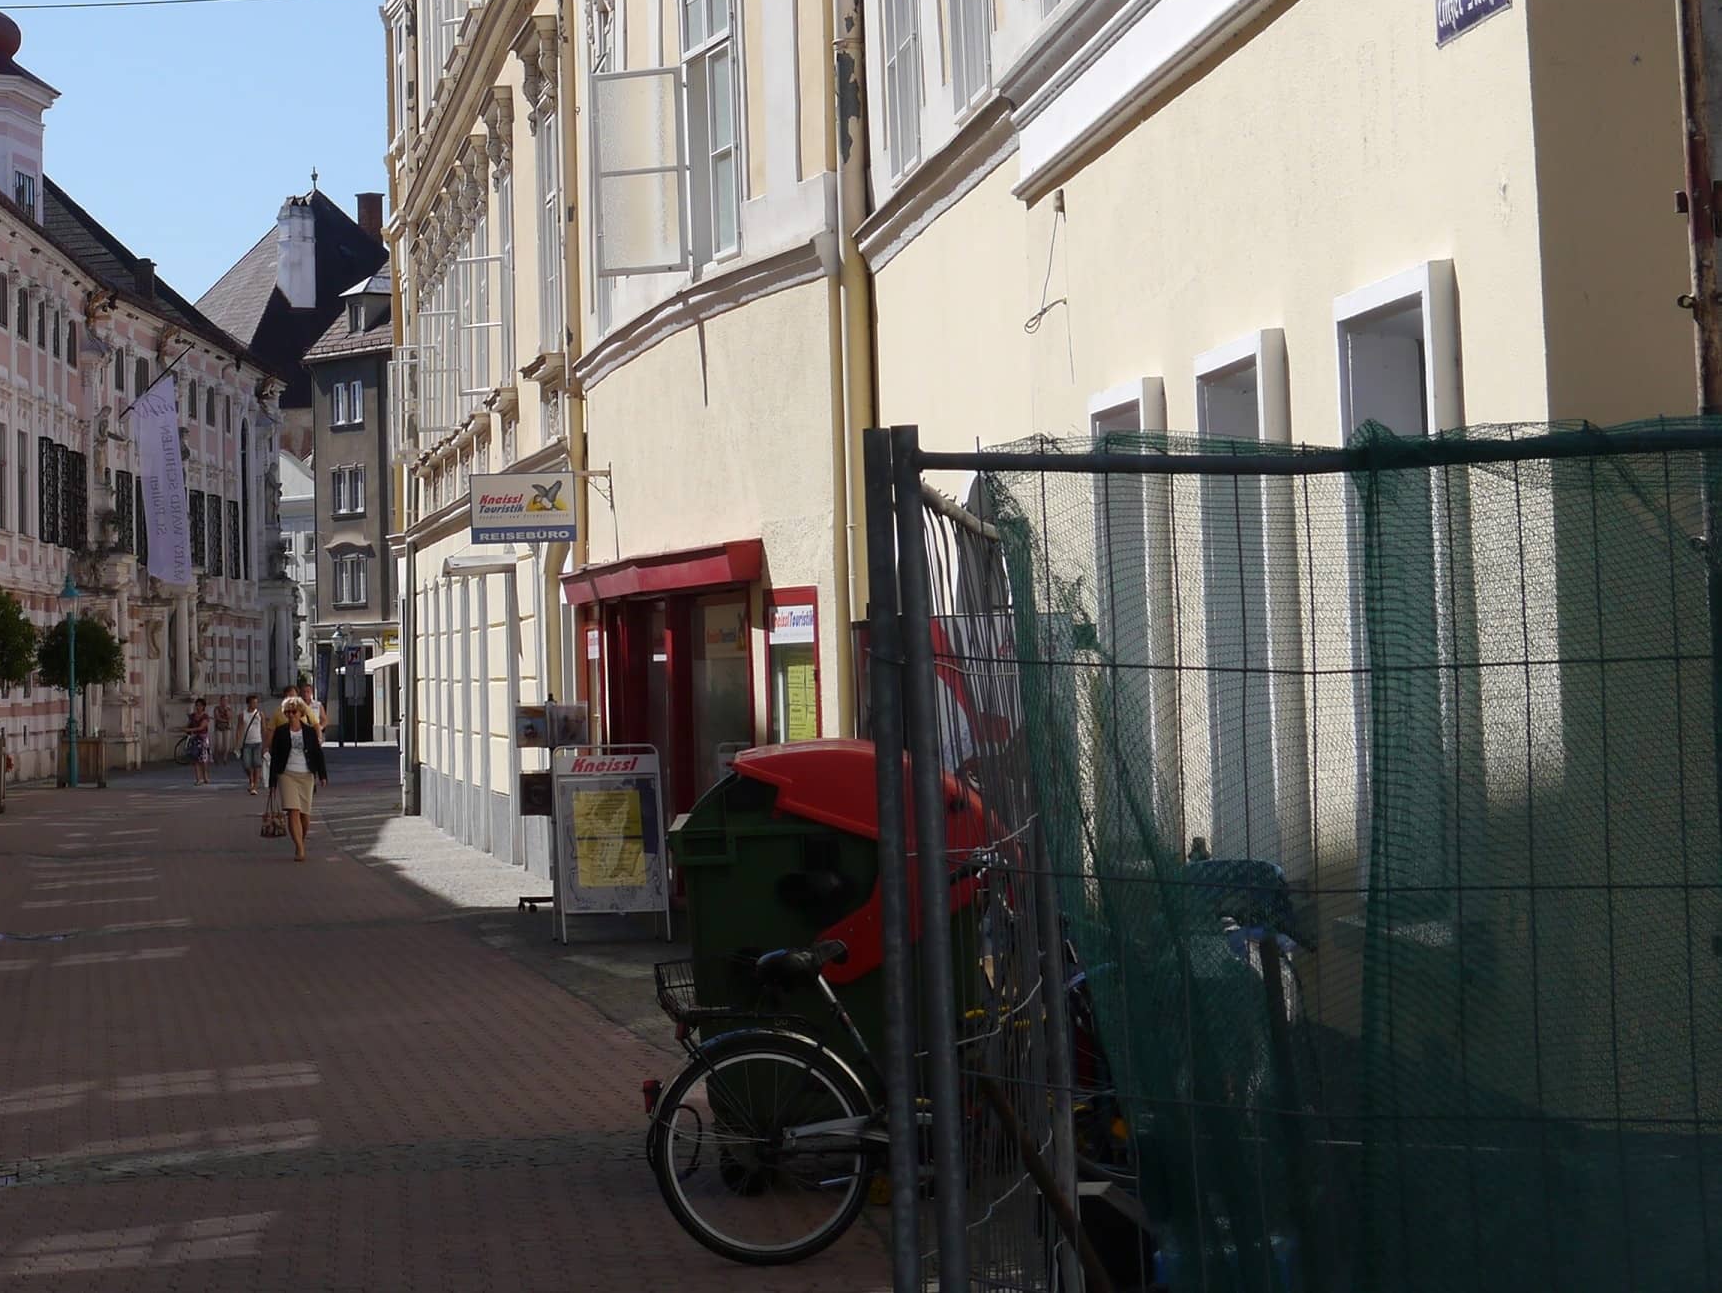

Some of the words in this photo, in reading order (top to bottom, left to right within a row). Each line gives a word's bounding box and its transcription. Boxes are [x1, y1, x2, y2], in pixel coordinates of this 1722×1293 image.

[479, 505, 524, 514] Touristik
[479, 530, 570, 541] REISEBÜRO
[571, 757, 638, 773] Kneissl
